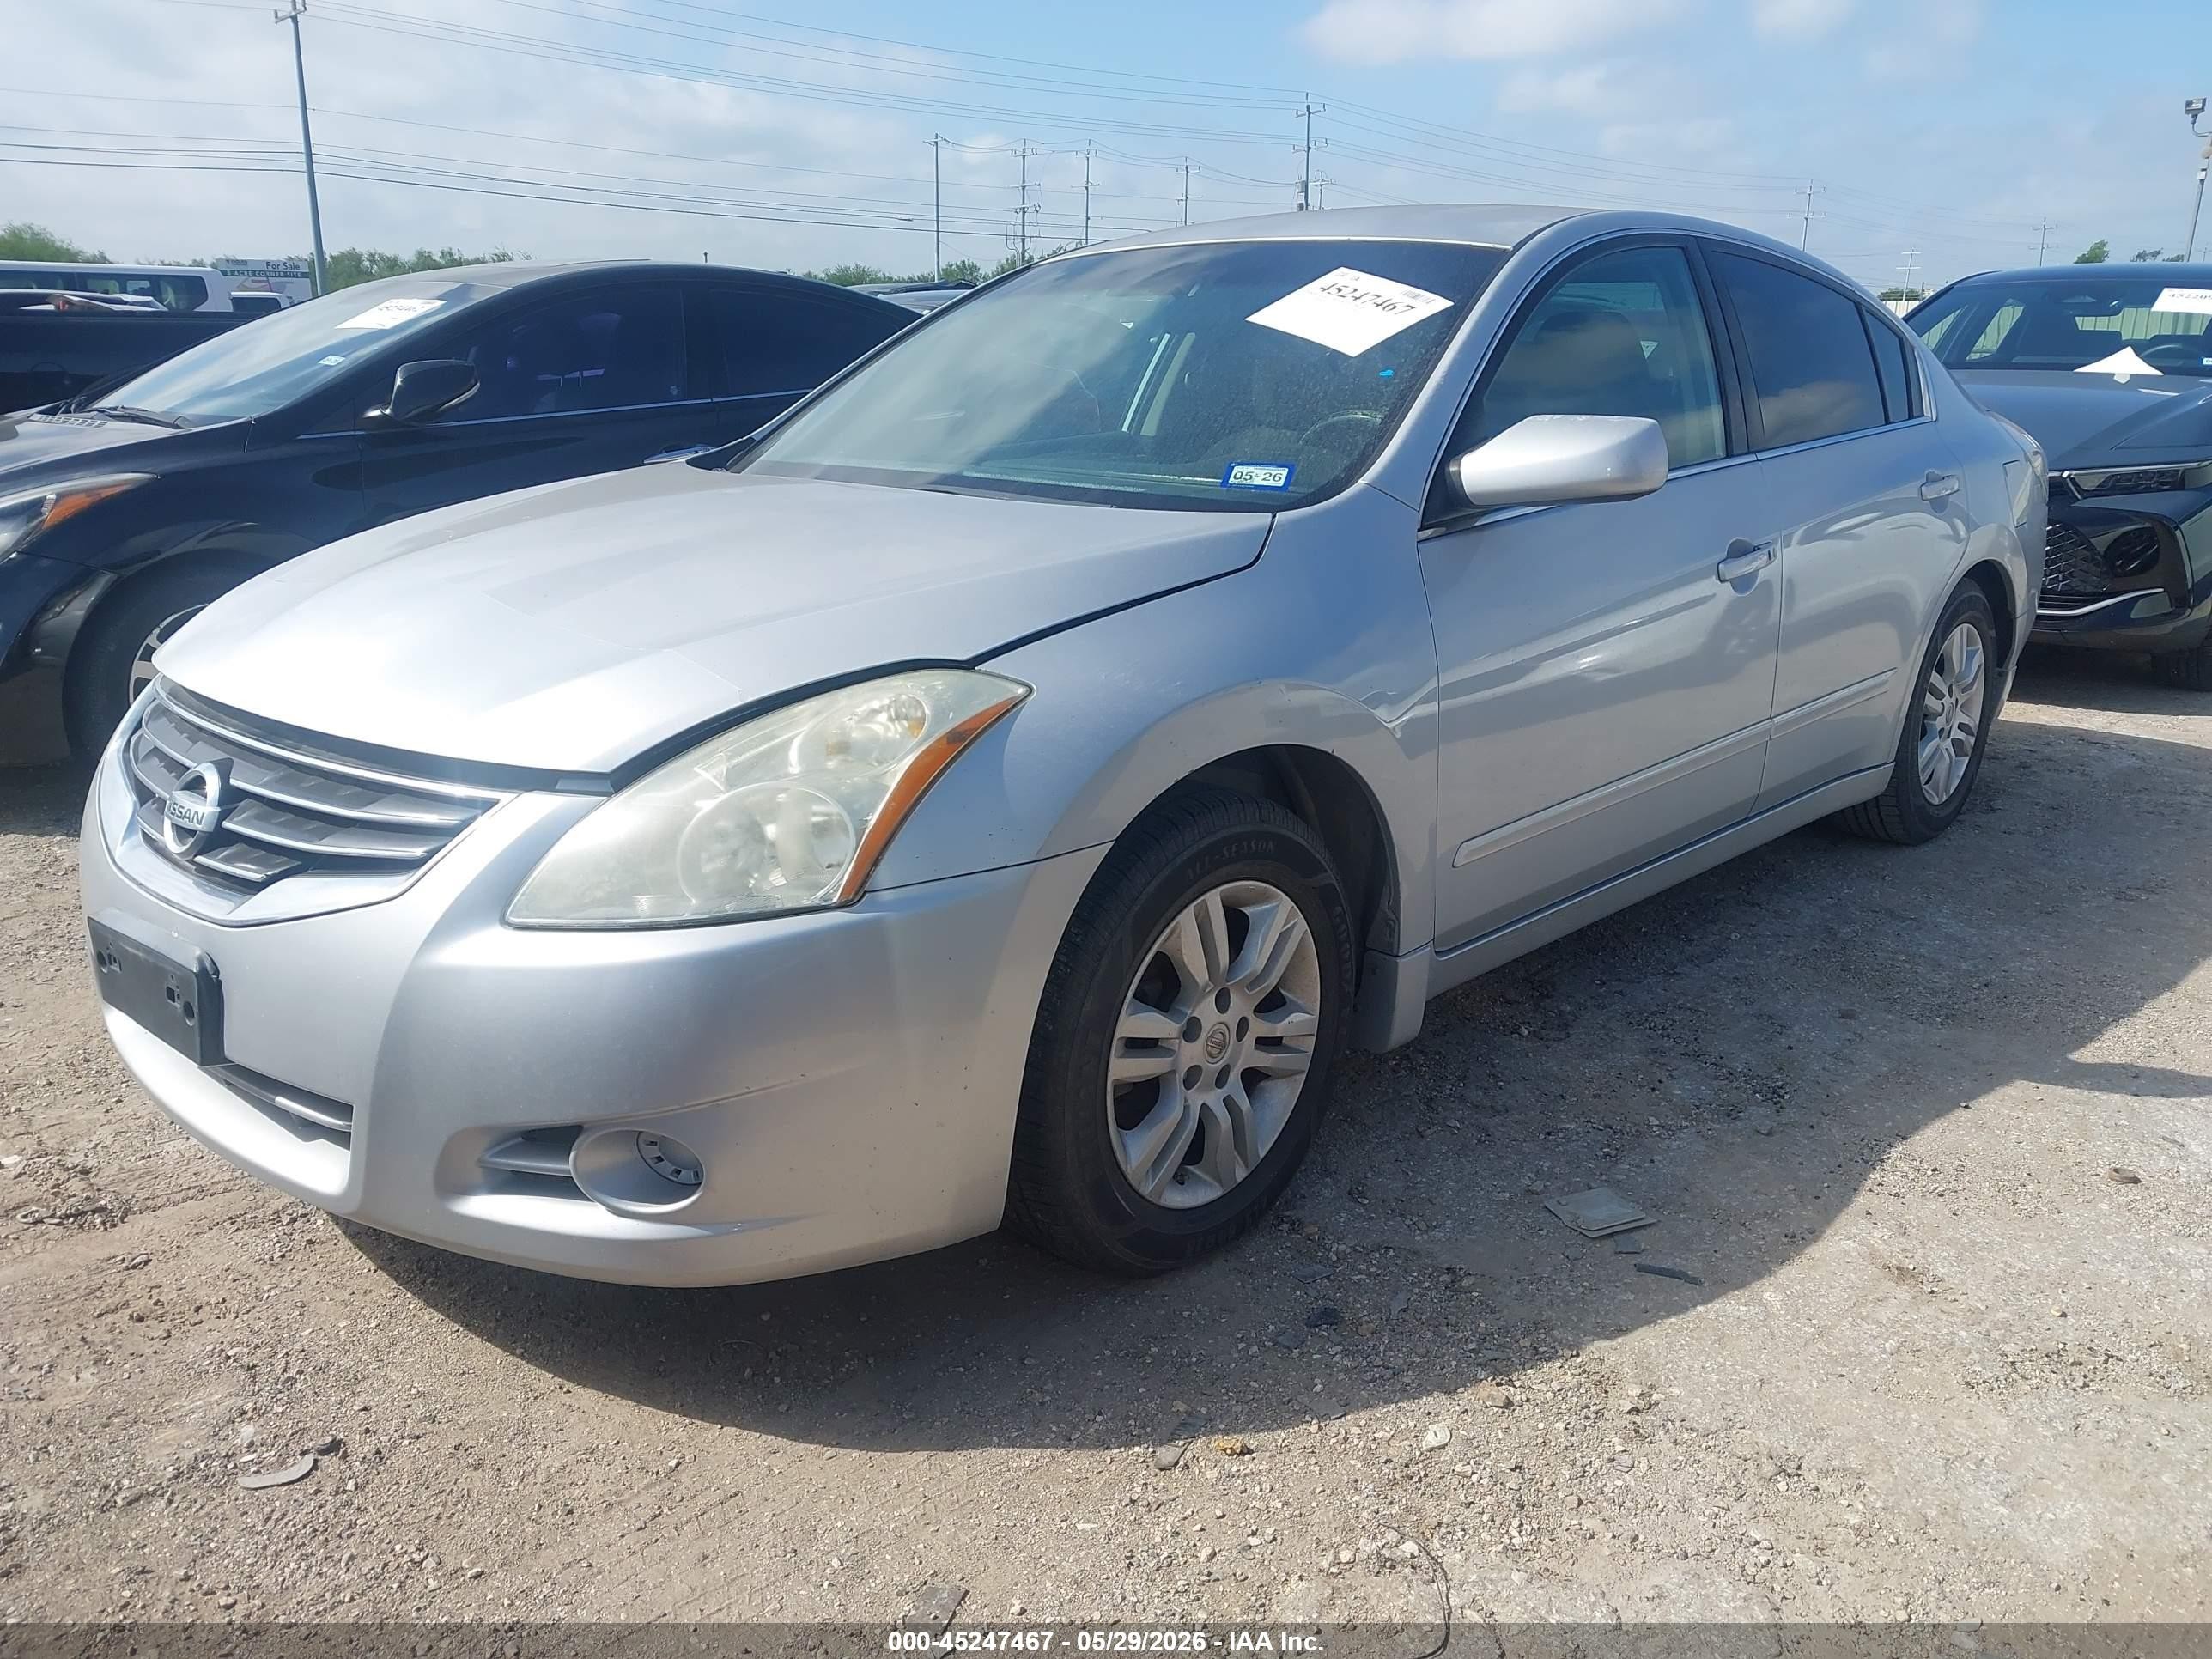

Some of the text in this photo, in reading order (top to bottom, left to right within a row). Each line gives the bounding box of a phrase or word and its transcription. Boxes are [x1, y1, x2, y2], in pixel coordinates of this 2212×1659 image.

[265, 261, 301, 270] For Sale
[1320, 283, 1416, 315] 45247467
